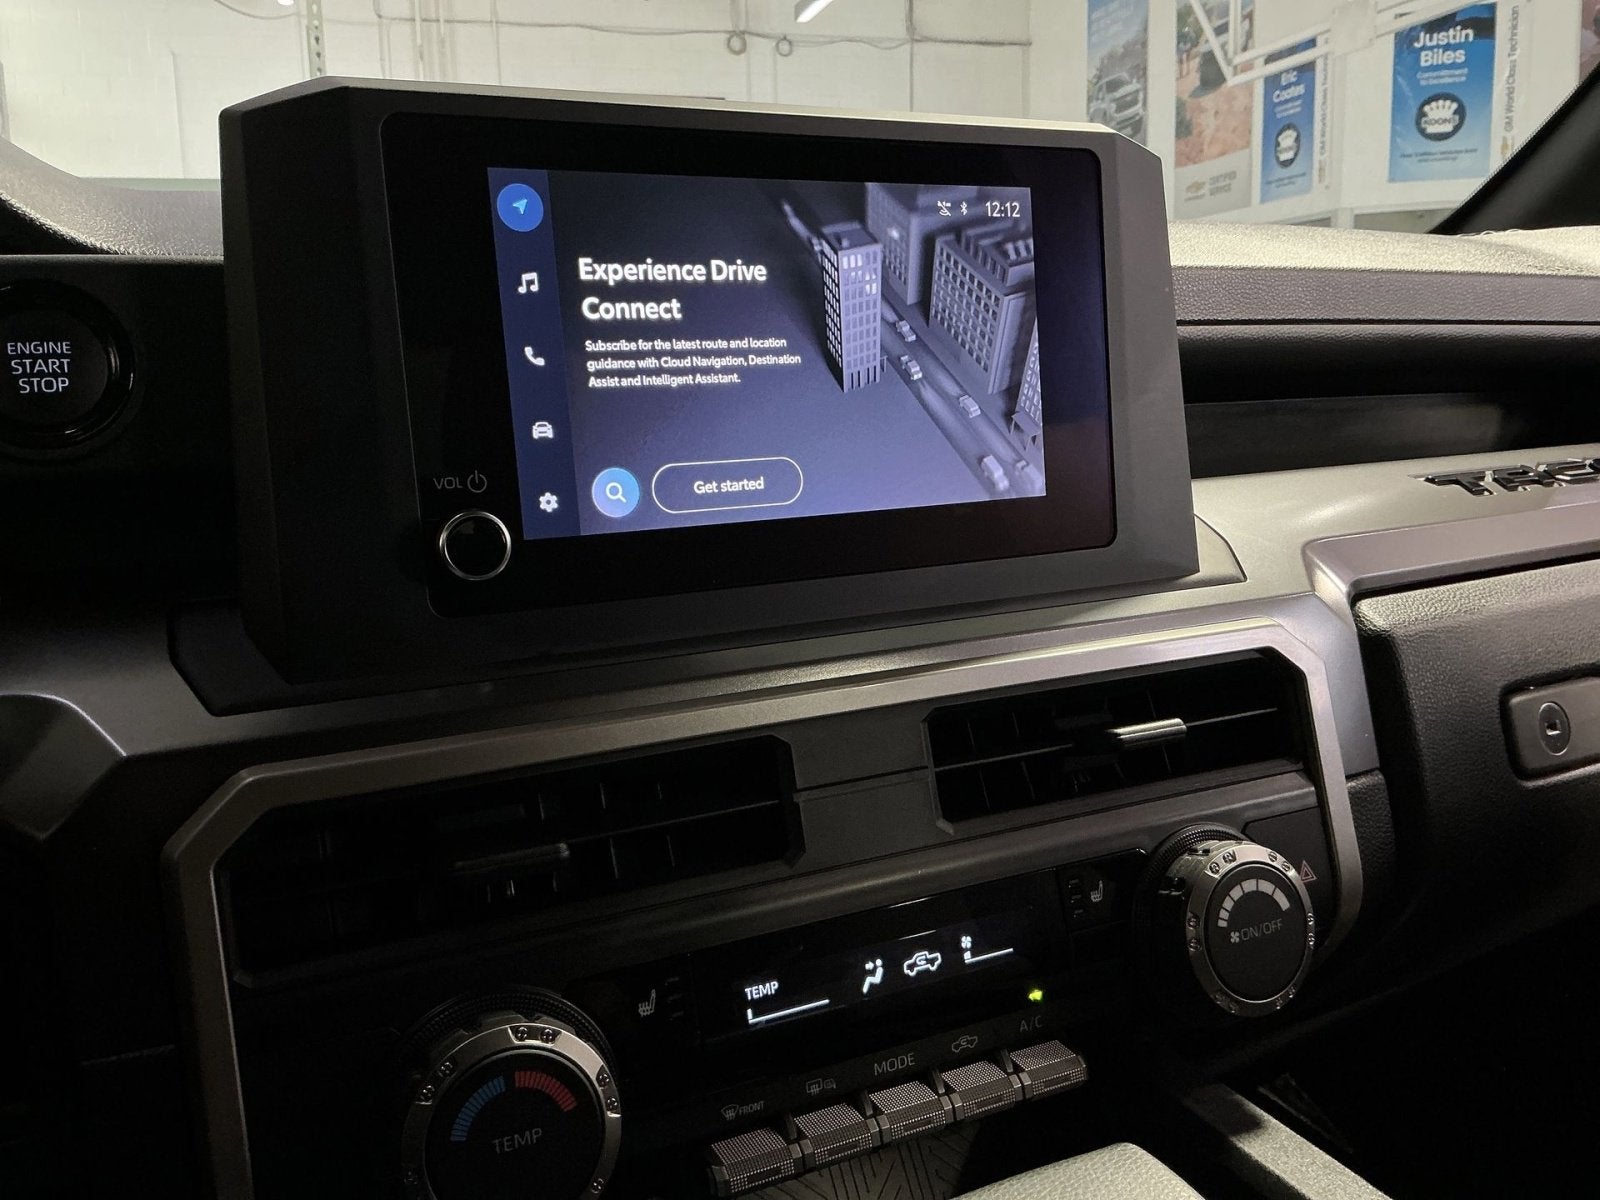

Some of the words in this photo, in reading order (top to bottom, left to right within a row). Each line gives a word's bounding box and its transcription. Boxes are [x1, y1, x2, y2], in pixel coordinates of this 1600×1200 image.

[1413, 25, 1474, 48] Justin
[1507, 5, 1520, 58] Technician
[1420, 49, 1466, 67] Biles
[1504, 86, 1515, 114] World
[985, 201, 1021, 217] 12:12
[577, 257, 707, 286] Experience
[710, 258, 768, 282] Drive
[581, 296, 683, 321] Connect
[6, 341, 72, 355] ENGINE
[585, 339, 637, 352] Subscribe
[638, 338, 654, 350] for
[654, 338, 672, 350] the
[672, 338, 701, 350] latest
[702, 338, 728, 349] route
[729, 338, 748, 349] and
[749, 337, 787, 348] location
[11, 358, 71, 375] START
[586, 357, 636, 372] guidance
[637, 356, 659, 368] with
[660, 355, 692, 367] Cloud
[692, 354, 748, 369] Navigation,
[748, 353, 802, 366] Destination
[18, 377, 69, 394] STOP
[588, 375, 620, 388] Assist
[620, 375, 642, 387] and
[642, 374, 694, 388] Intelligent
[694, 372, 742, 384] Assistant.
[432, 476, 464, 490] VOL
[693, 480, 719, 494] Get
[720, 476, 765, 492] started
[1240, 918, 1284, 941] ON/OFF
[744, 980, 780, 1001] TEMP
[1018, 1014, 1045, 1033] A/C
[873, 1052, 916, 1077] MODE
[738, 1099, 766, 1115] FRONT
[491, 1127, 544, 1155] TEMP
